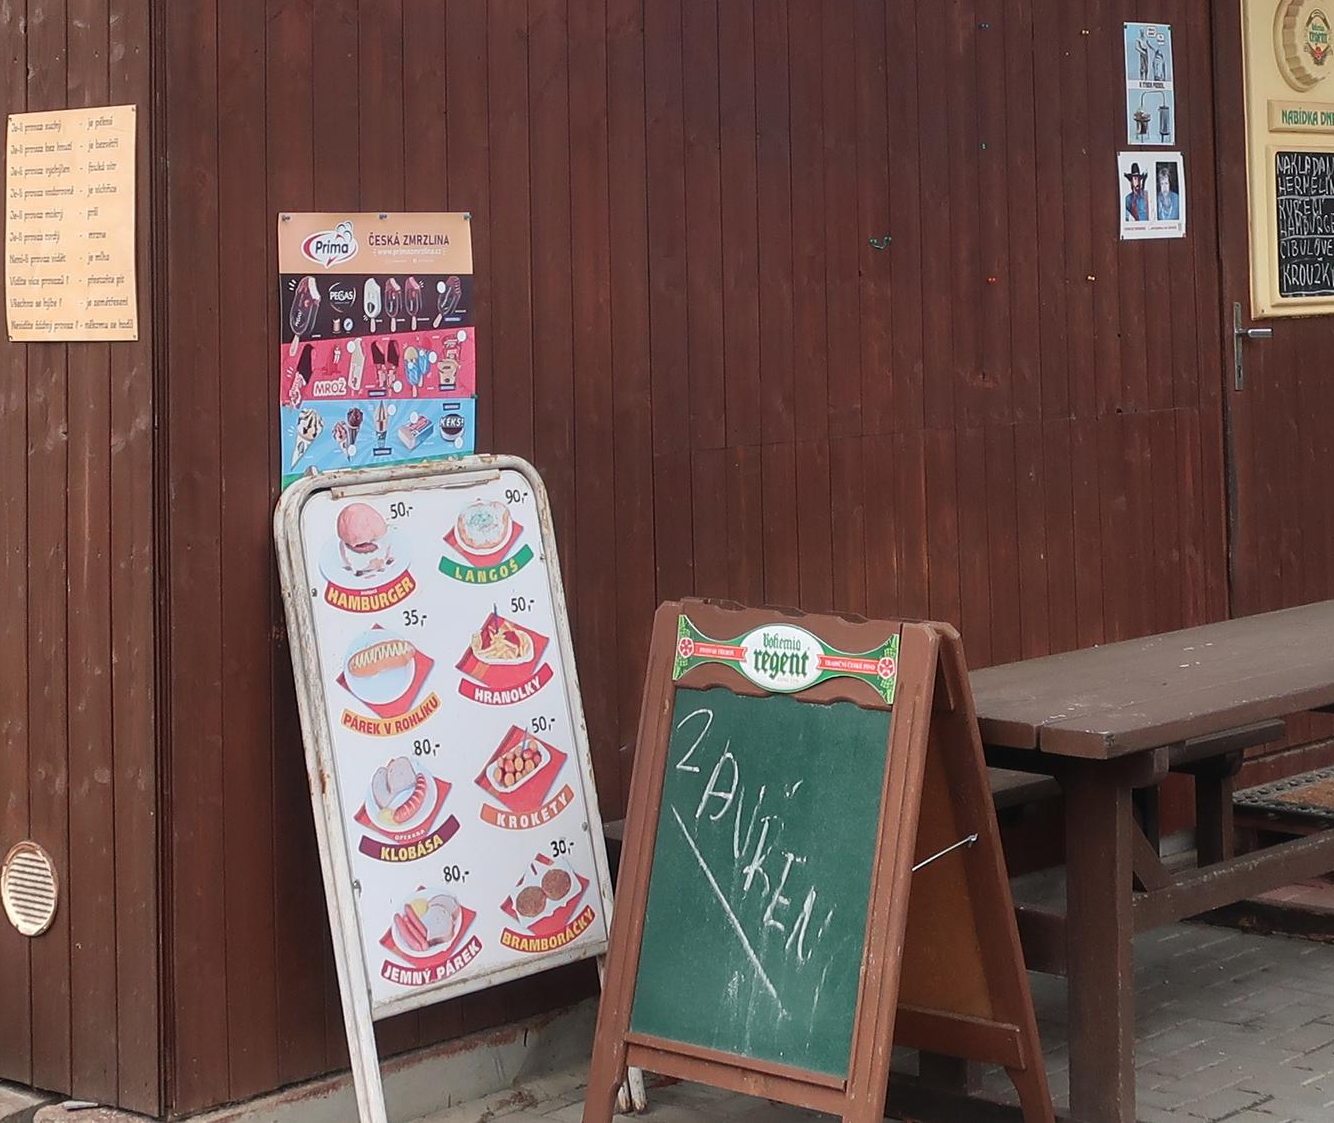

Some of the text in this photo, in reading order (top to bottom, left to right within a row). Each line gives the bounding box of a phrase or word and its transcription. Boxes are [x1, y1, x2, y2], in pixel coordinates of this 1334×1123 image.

[1281, 107, 1319, 126] NABÍDKA
[315, 231, 450, 254] Prima ČESKÁ ZMRZLINA
[329, 290, 354, 301] PEGAS
[505, 489, 528, 506] 90,-
[390, 502, 414, 520] 50,-
[455, 558, 519, 583] LANGOŠ
[327, 576, 414, 611] HAMBURGER
[511, 597, 535, 613] 50,-
[402, 609, 427, 627] 35,-
[763, 633, 801, 651] Bohemia
[753, 649, 810, 680] regent
[474, 677, 542, 704] HRANOLKY
[343, 696, 439, 735] PÁREK V ROHLÍKU
[531, 716, 555, 733] 50,-
[413, 739, 440, 756] 80,-
[496, 794, 569, 828] KROKETY
[380, 834, 443, 861] KLOBÁSA
[550, 839, 575, 857] 30,-
[443, 865, 470, 884] 80,-
[383, 939, 480, 985] JEMNÝ PÁREK
